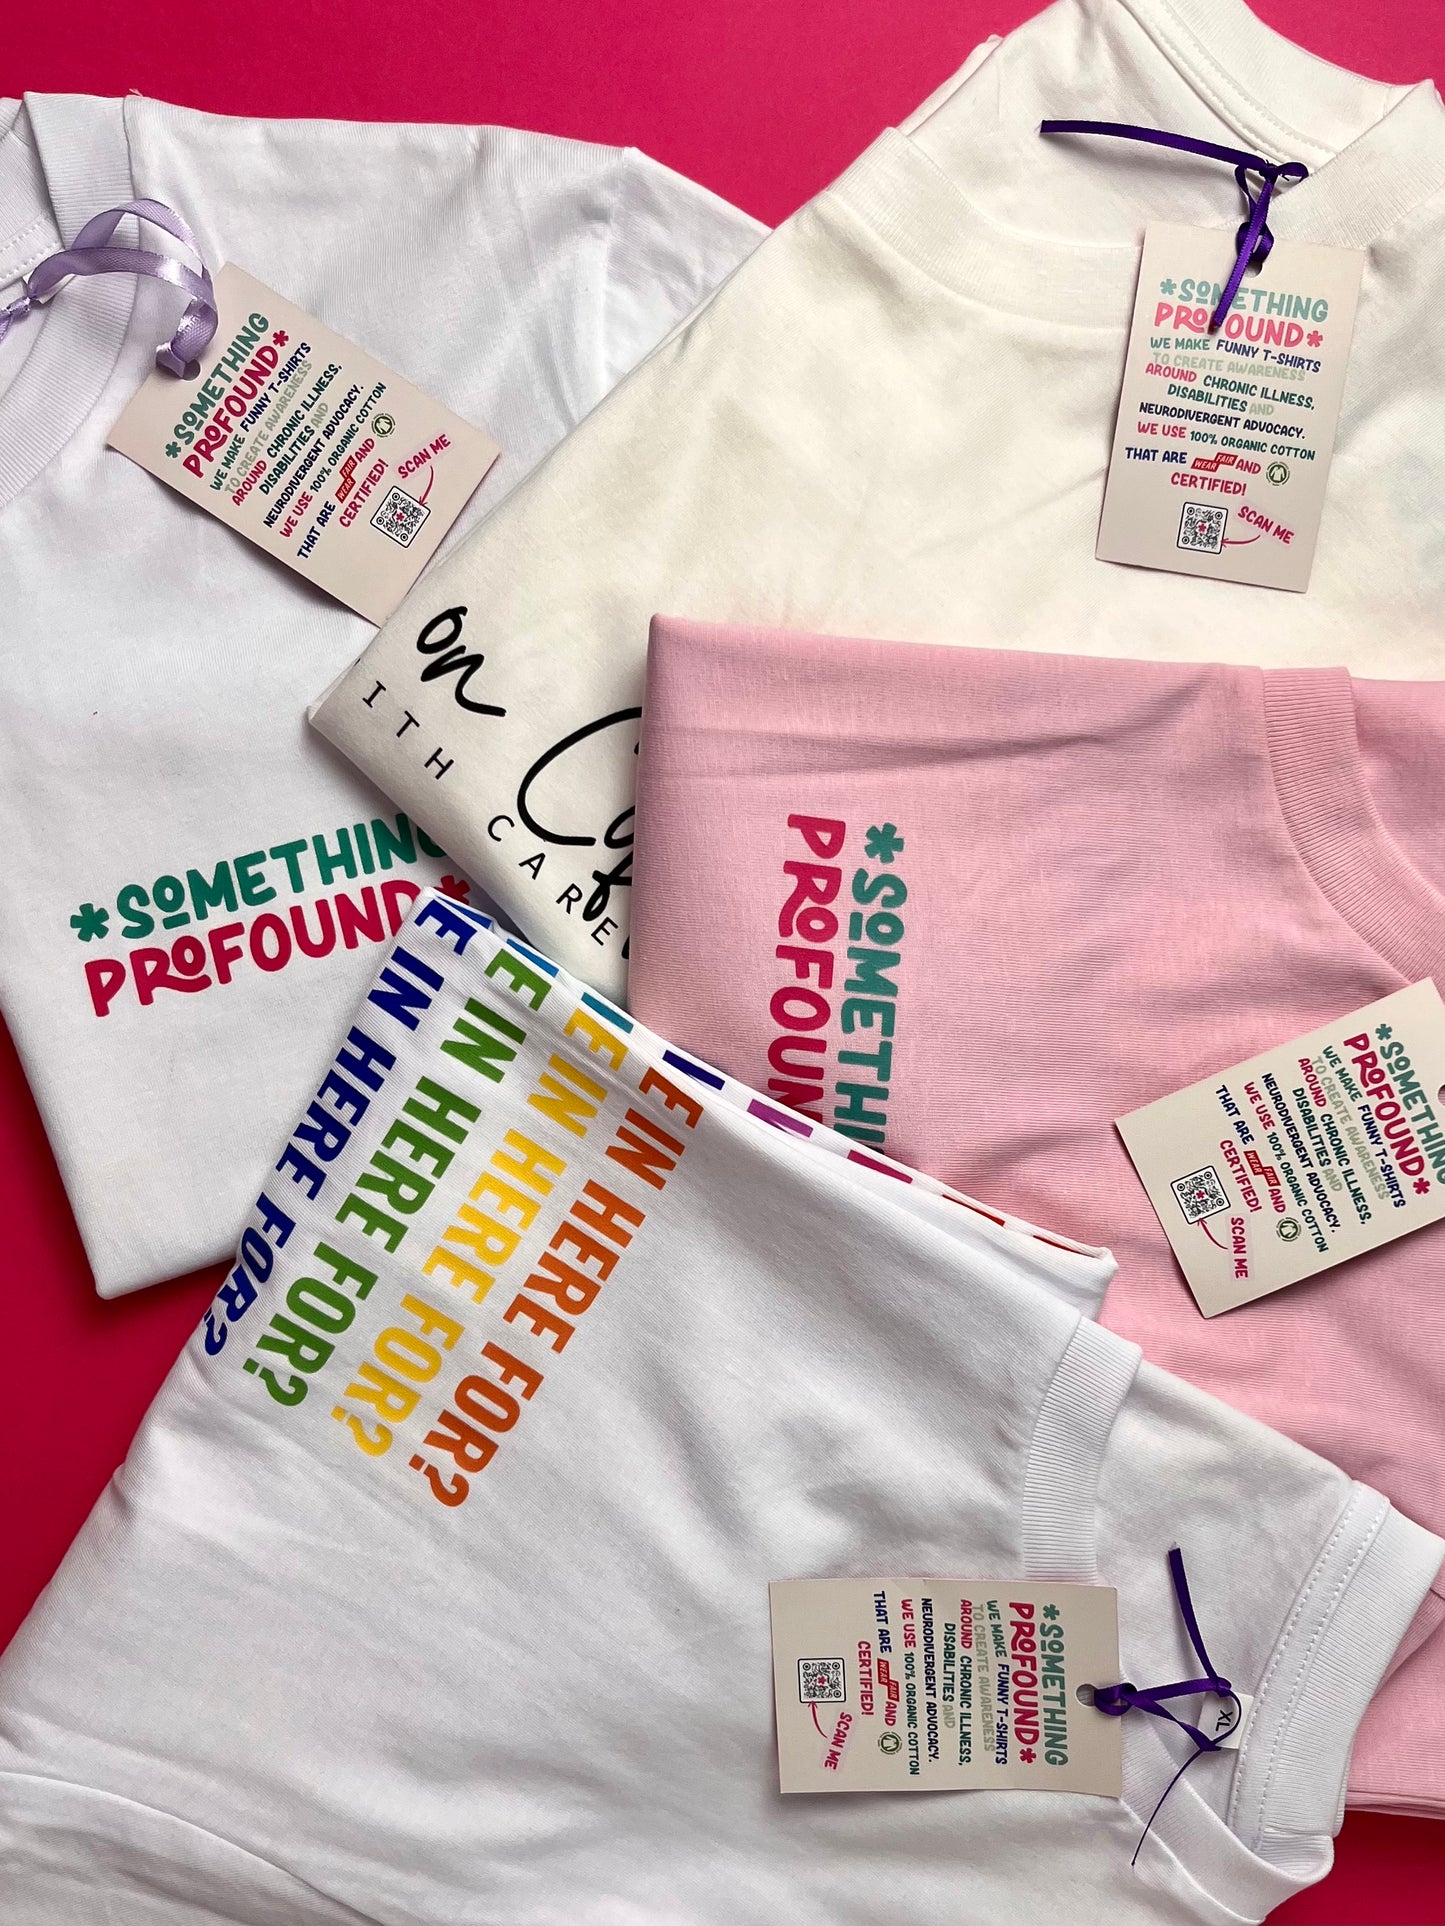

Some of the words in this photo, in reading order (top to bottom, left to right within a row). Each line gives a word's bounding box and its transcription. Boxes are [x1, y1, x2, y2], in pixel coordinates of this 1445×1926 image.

[1154, 302, 1323, 347] PROOUND
[1151, 337, 1171, 349] WE
[1175, 338, 1211, 350] MAKE
[1216, 339, 1259, 358] FUNNY
[1264, 350, 1321, 372] T-SHIRTS
[1153, 352, 1170, 365] TO
[1174, 355, 1224, 371] CREATE
[1227, 362, 1306, 381] AWARENESS
[1146, 363, 1196, 382] AROUND
[1204, 375, 1257, 396] CHRONIC
[1260, 387, 1314, 410] ILLNESS,
[1168, 384, 1247, 412] DISABILITIES
[1249, 403, 1274, 415] AND
[210, 469, 228, 490] WE
[222, 434, 245, 469] MAKE
[240, 393, 271, 432] FUNNY
[268, 343, 310, 393] T-SHIRTS
[224, 478, 240, 493] TO
[237, 430, 269, 476] CREATE
[265, 360, 312, 431] AWARENESS
[232, 460, 266, 506] AROUND
[267, 410, 304, 458] CHRONIC
[301, 364, 342, 411] ILLNESS,
[1140, 402, 1240, 428] NEURODIVERGENT
[1243, 419, 1304, 439] ADVOCACY.
[259, 426, 314, 495] DISABILITIES
[311, 403, 328, 428] AND
[263, 438, 325, 528] NEURODIVERGENT
[322, 384, 363, 440] ADVOCACY.
[280, 516, 298, 537] WE
[292, 491, 313, 516] USE
[310, 467, 331, 492] 100%
[328, 424, 359, 466] ORGANIC
[356, 382, 386, 424] COTTON
[355, 438, 374, 462] AND
[398, 448, 431, 478] SCAN
[430, 434, 450, 454] ME
[1126, 448, 1158, 461] THAT
[1138, 422, 1158, 434] WE
[1162, 424, 1186, 438] USE
[1191, 431, 1217, 444] 100%
[1221, 436, 1267, 452] ORGANIC
[1270, 444, 1315, 460] COTTON
[1162, 451, 1187, 464] ARE
[1215, 454, 1234, 464] FAIR
[340, 458, 356, 477] FAIR
[1171, 472, 1246, 496] CERTIFIED!
[1194, 459, 1216, 471] WEAR
[1234, 458, 1261, 474] AND
[336, 477, 355, 500] WEAR
[340, 458, 388, 527] CERTIFIED!
[317, 501, 336, 527] ARE
[1238, 506, 1274, 532] SCAN
[1273, 525, 1294, 544] ME
[297, 526, 320, 558] THAT
[362, 680, 454, 779] ITH
[368, 946, 444, 1031] IN
[440, 998, 527, 1083] IN
[276, 1026, 397, 1200] HERE
[527, 1055, 608, 1138] IN
[1216, 1085, 1240, 1116] THAT
[1233, 1121, 1254, 1145] ARE
[1292, 1088, 1331, 1166] DISABILITIES
[1322, 1168, 1342, 1191] AND
[1298, 1058, 1326, 1107] AROUND
[1321, 1114, 1350, 1166] CHRONIC
[1342, 1169, 1371, 1224] ILLNESS,
[1311, 1056, 1326, 1074] TO
[1321, 1077, 1352, 1124] CREATE
[1345, 1127, 1390, 1199] AWARENESS
[1323, 1046, 1342, 1068] WE
[1335, 1068, 1362, 1102] MAKE
[1358, 1104, 1383, 1144] FUNNY
[1376, 1148, 1406, 1207] T-SHIRTS
[335, 1076, 482, 1253] HERE
[605, 1108, 685, 1190] IN
[1244, 1082, 1262, 1104] WE
[1256, 1104, 1275, 1130] USE
[1267, 1132, 1286, 1160] 100%
[1280, 1162, 1308, 1206] ORGANIC
[1302, 1209, 1328, 1252] COTTON
[1245, 1151, 1262, 1174] WEAR
[1262, 1073, 1314, 1168] NEURODIVERGENT
[1306, 1172, 1340, 1232] ADVOCACY.
[1220, 1140, 1262, 1212] CERTIFIED!
[1263, 1166, 1277, 1186] FAIR
[422, 1128, 568, 1304] HERE
[1268, 1189, 1286, 1212] AND
[1231, 1218, 1246, 1254] SCAN
[204, 1193, 296, 1356] FOR?
[504, 1180, 646, 1353] HERE
[1234, 1259, 1248, 1278] ME
[243, 1243, 379, 1406] FOR?
[331, 1293, 464, 1456] FOR?
[408, 1342, 545, 1507] FOR?
[874, 1591, 888, 1624] THAT
[902, 1599, 914, 1620] WE
[961, 1600, 972, 1648] AROUND
[971, 1604, 984, 1620] TO
[987, 1600, 1000, 1620] WE
[878, 1629, 892, 1653] ARE
[904, 1624, 916, 1648] USE
[922, 1598, 936, 1698] NEURODIVERGENT
[974, 1625, 989, 1672] CREATE
[991, 1624, 1007, 1657] MAKE
[858, 1641, 874, 1715] CERTIFIED!
[878, 1661, 887, 1683] WEAR
[904, 1652, 915, 1680] 100%
[942, 1623, 956, 1702] DISABILITIES
[960, 1656, 972, 1708] CHRONIC
[888, 1681, 897, 1698] FAIR
[906, 1683, 917, 1728] ORGANIC
[997, 1664, 1009, 1705] FUNNY
[831, 1712, 851, 1748] SCAN
[885, 1701, 896, 1726] AND
[926, 1702, 939, 1762] ADVOCACY.
[942, 1705, 955, 1728] AND
[978, 1676, 995, 1751] AWARENESS
[1216, 1710, 1233, 1732] XL
[908, 1732, 919, 1774] COTTON
[958, 1712, 971, 1765] ILLNESS,
[996, 1709, 1008, 1764] T-SHIRTS
[825, 1749, 840, 1770] ME
